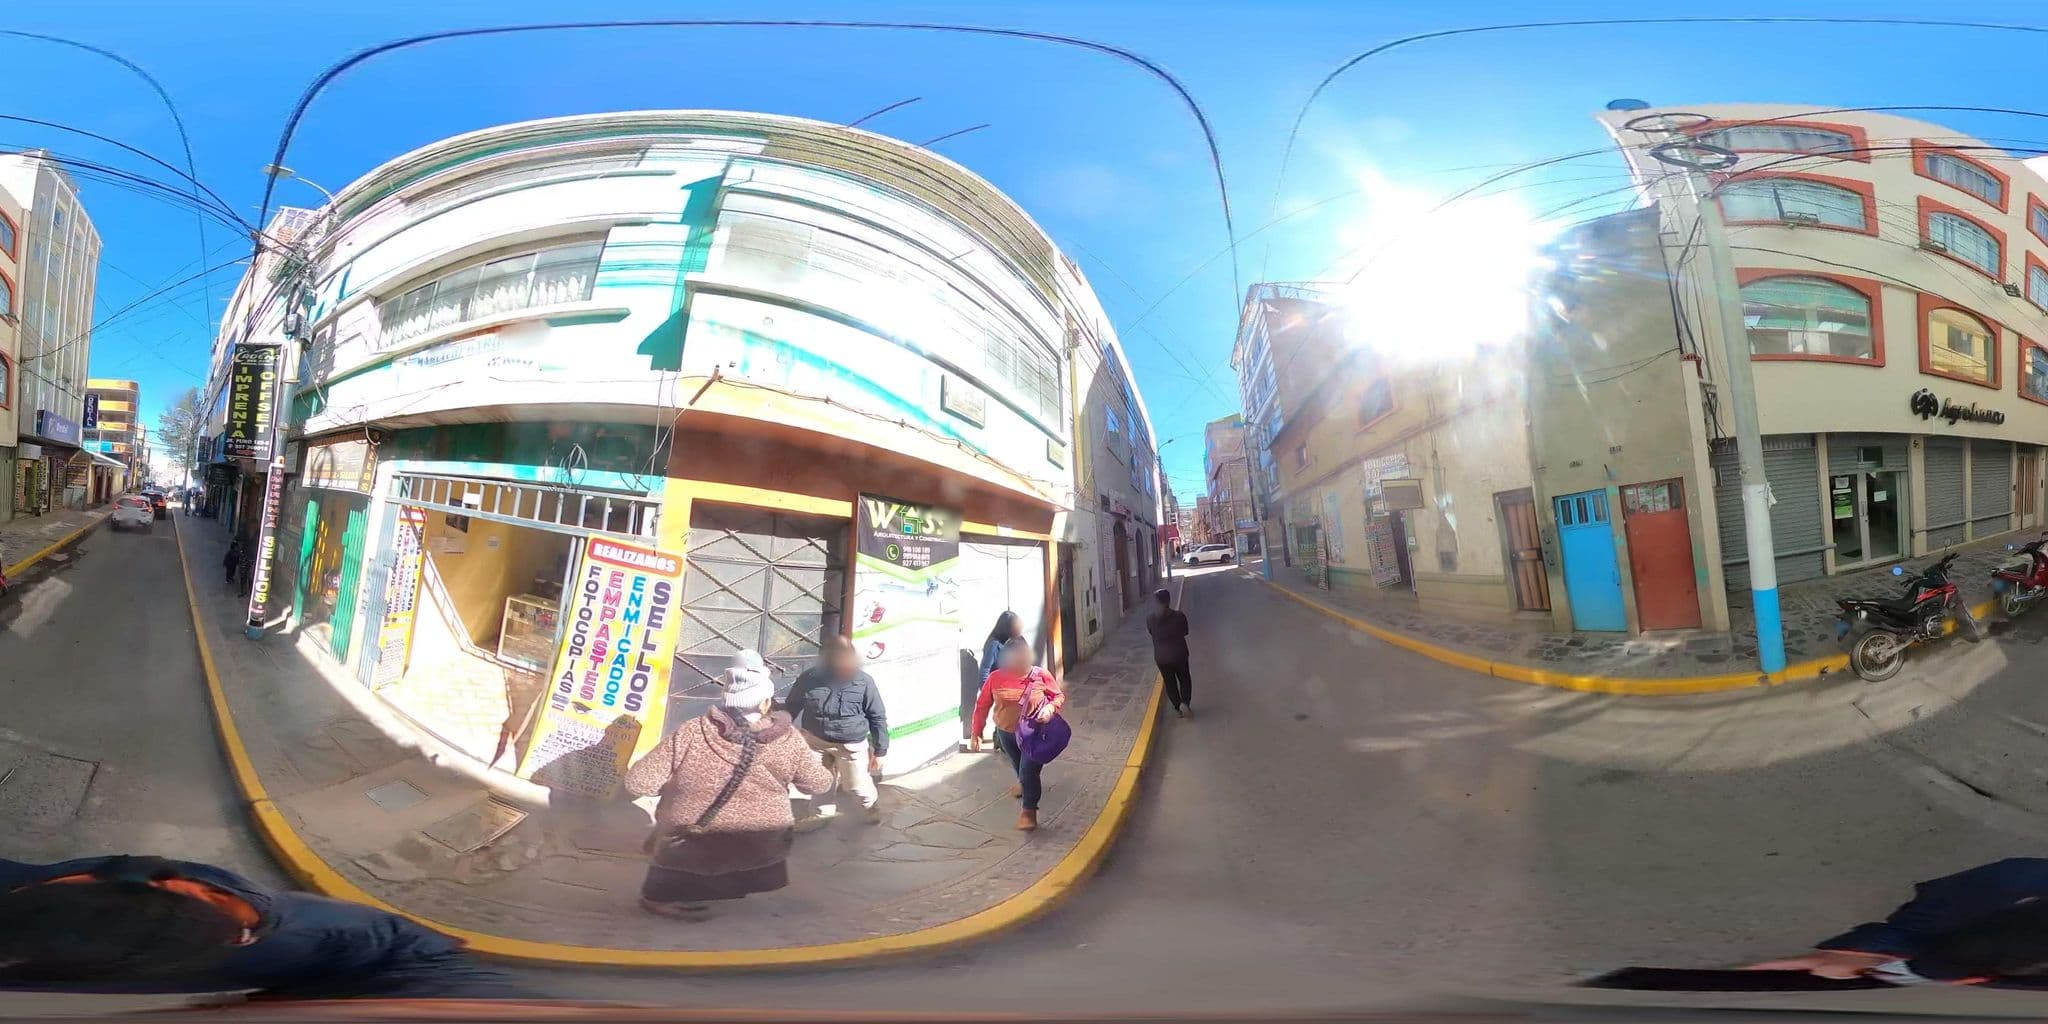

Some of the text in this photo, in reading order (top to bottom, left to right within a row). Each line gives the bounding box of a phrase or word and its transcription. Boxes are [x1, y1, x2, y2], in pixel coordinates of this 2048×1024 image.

[232, 366, 253, 438] IMPRENTA
[255, 371, 276, 433] OFFSET
[255, 535, 275, 604] SELLOS
[592, 543, 677, 573] REALIZAMOS
[559, 565, 602, 694] FOTOCOPIAS
[579, 570, 625, 701] EMPASTES
[602, 576, 646, 706] ENMICADOS
[624, 581, 671, 712] SELLOS
